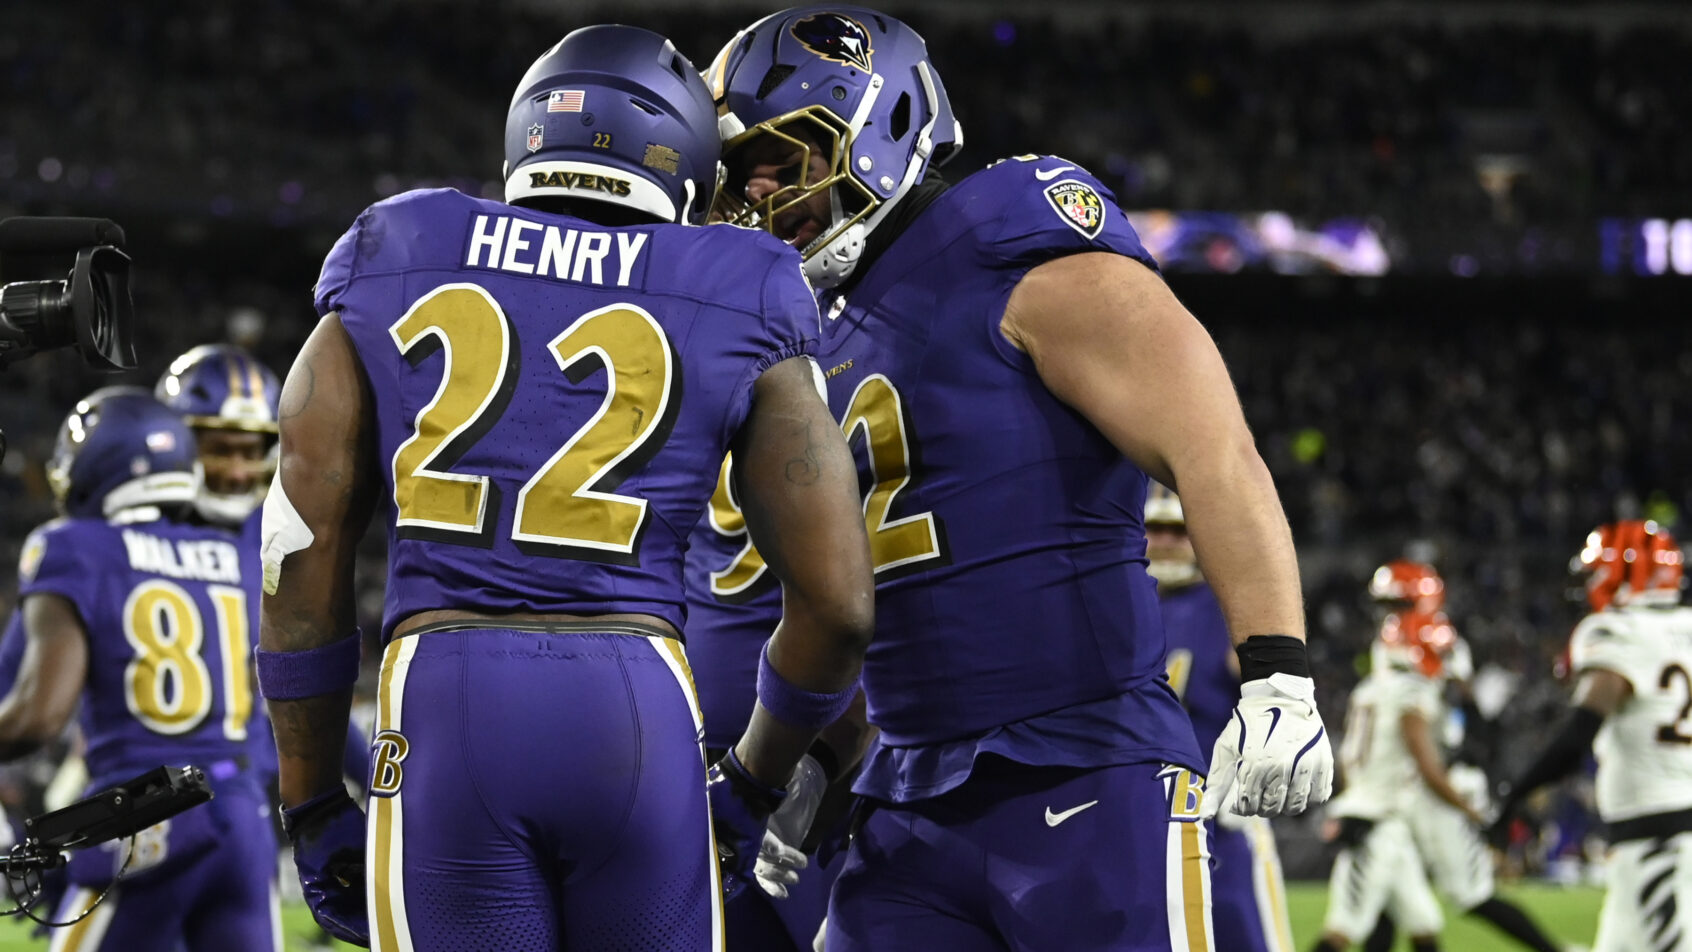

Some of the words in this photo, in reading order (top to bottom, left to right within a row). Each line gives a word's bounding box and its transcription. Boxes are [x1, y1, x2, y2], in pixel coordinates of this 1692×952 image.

[529, 135, 541, 147] NFL
[593, 132, 611, 149] 22
[529, 171, 632, 197] RAVENS
[466, 214, 648, 287] HENRY
[826, 359, 853, 379] VENS
[388, 282, 675, 556] 22
[122, 528, 241, 584] WALKER
[122, 578, 252, 742] 81
[370, 730, 410, 795] B
